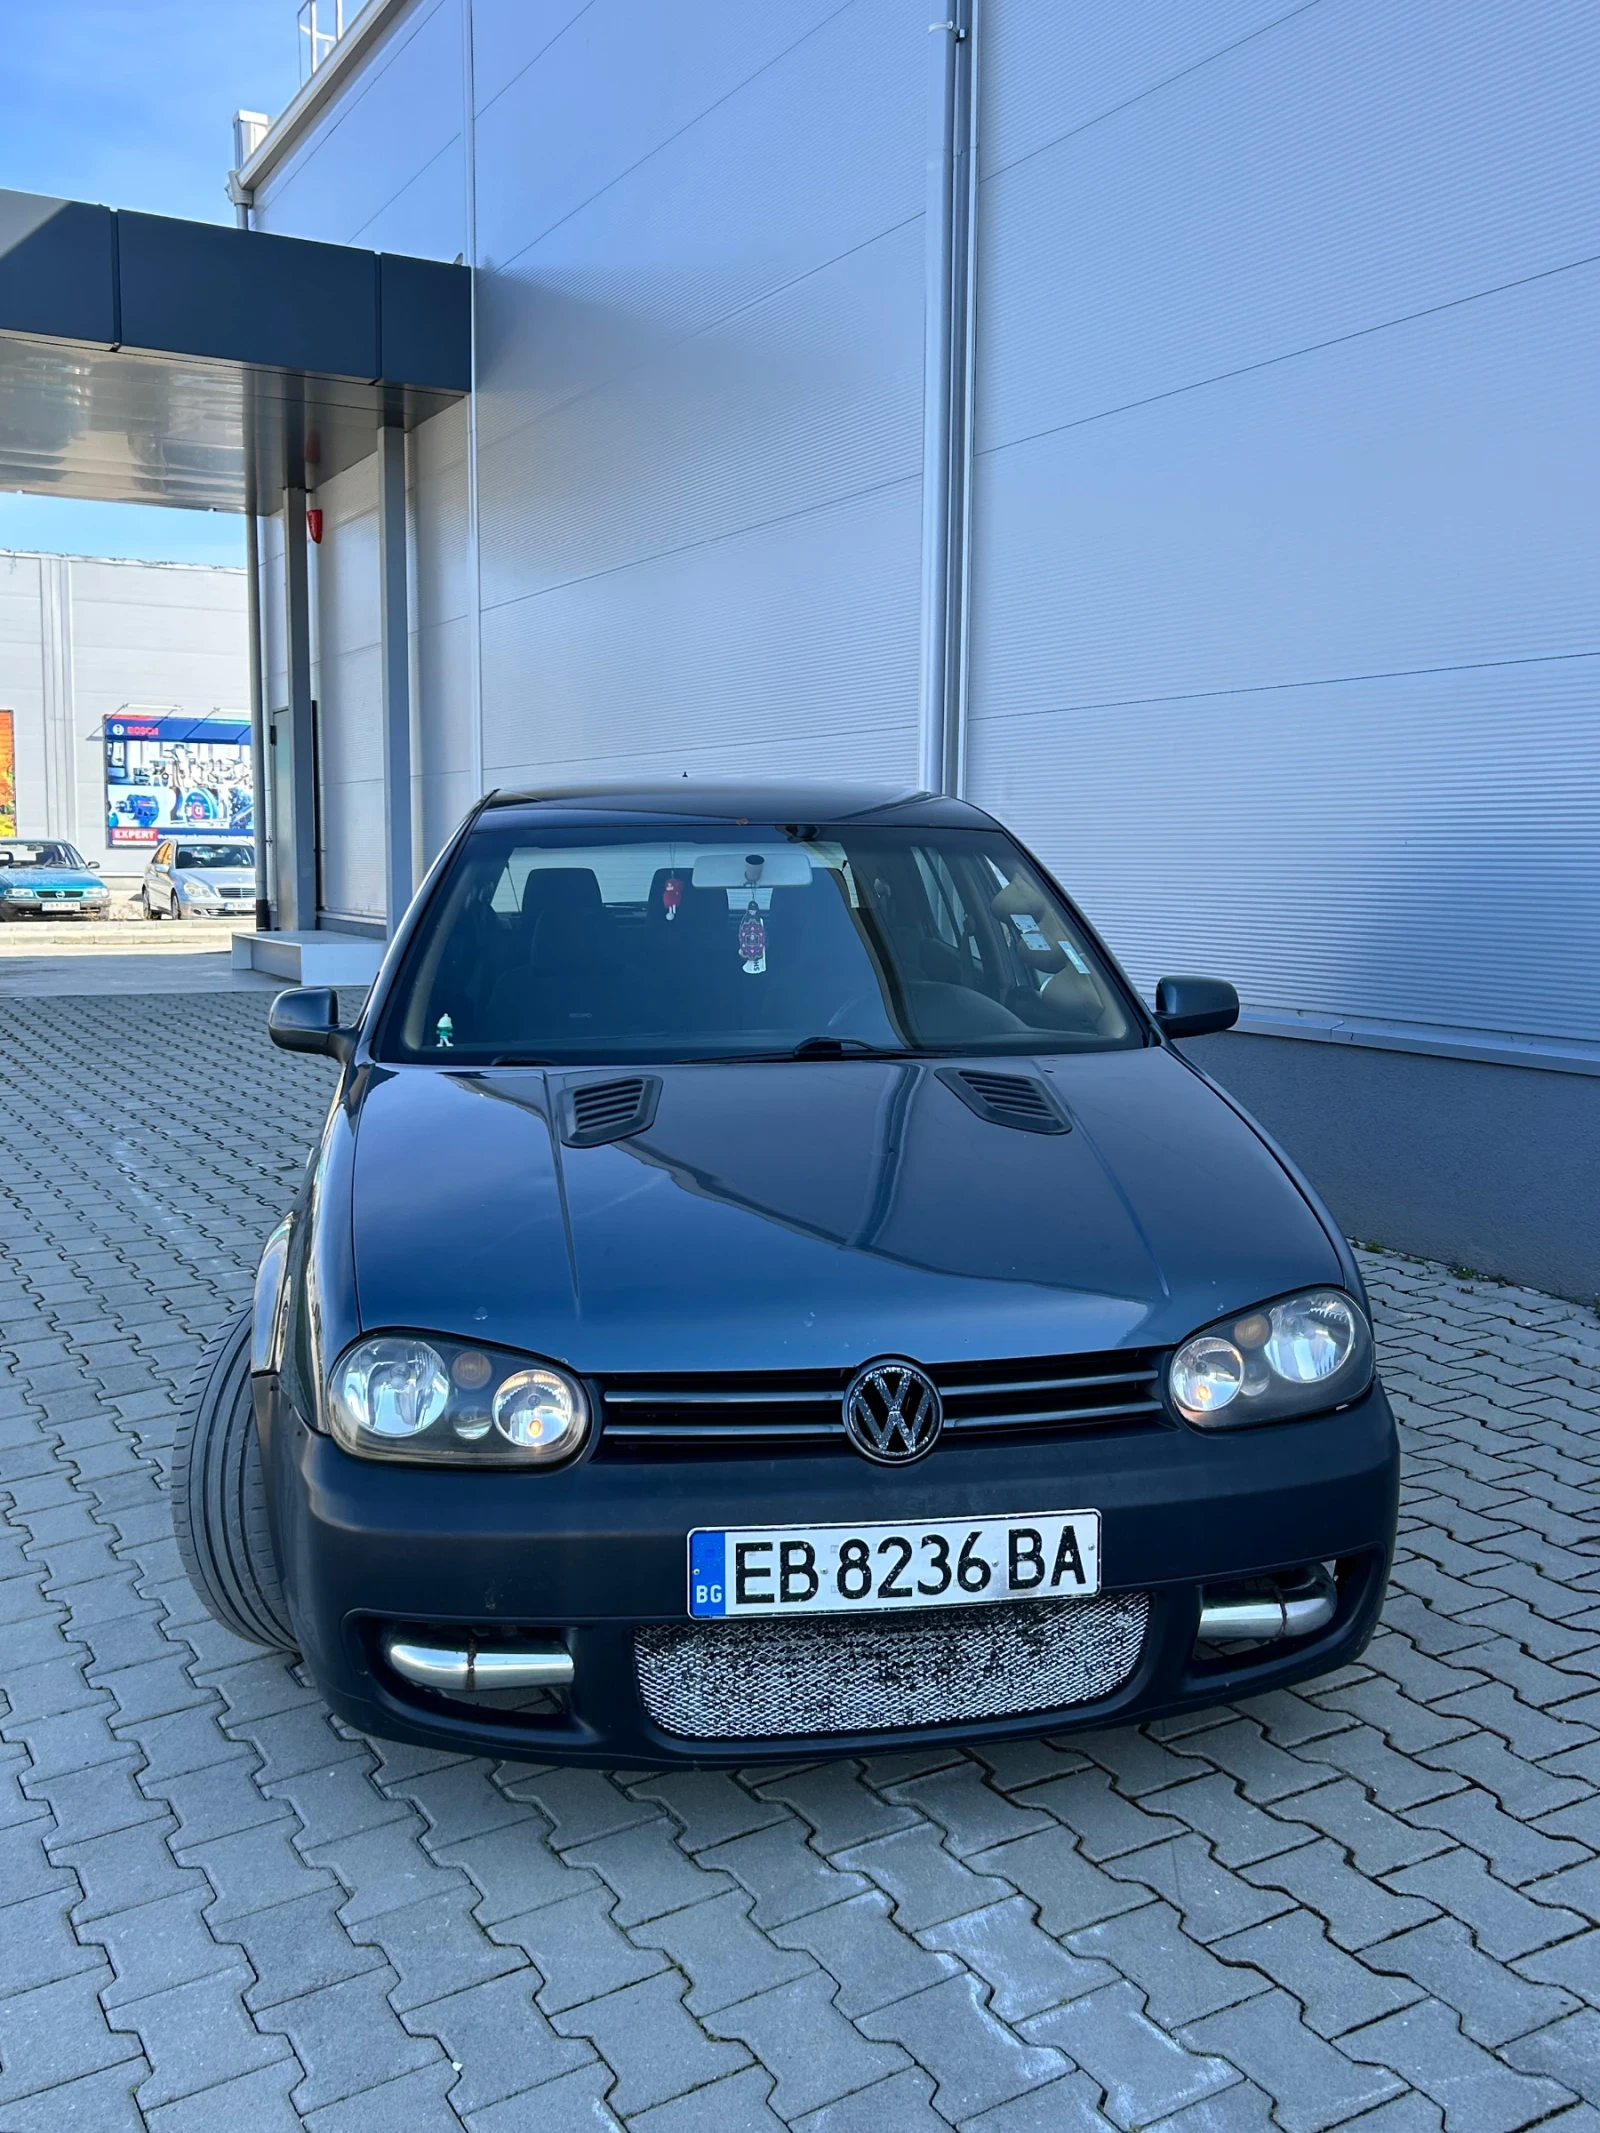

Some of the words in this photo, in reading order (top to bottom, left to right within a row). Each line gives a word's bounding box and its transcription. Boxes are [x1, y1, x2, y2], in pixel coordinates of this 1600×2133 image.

[114, 830, 155, 839] EXPERT
[735, 1540, 820, 1604] EB
[836, 1531, 992, 1599] 8236
[1008, 1524, 1086, 1590] BA
[696, 1583, 723, 1604] BG
